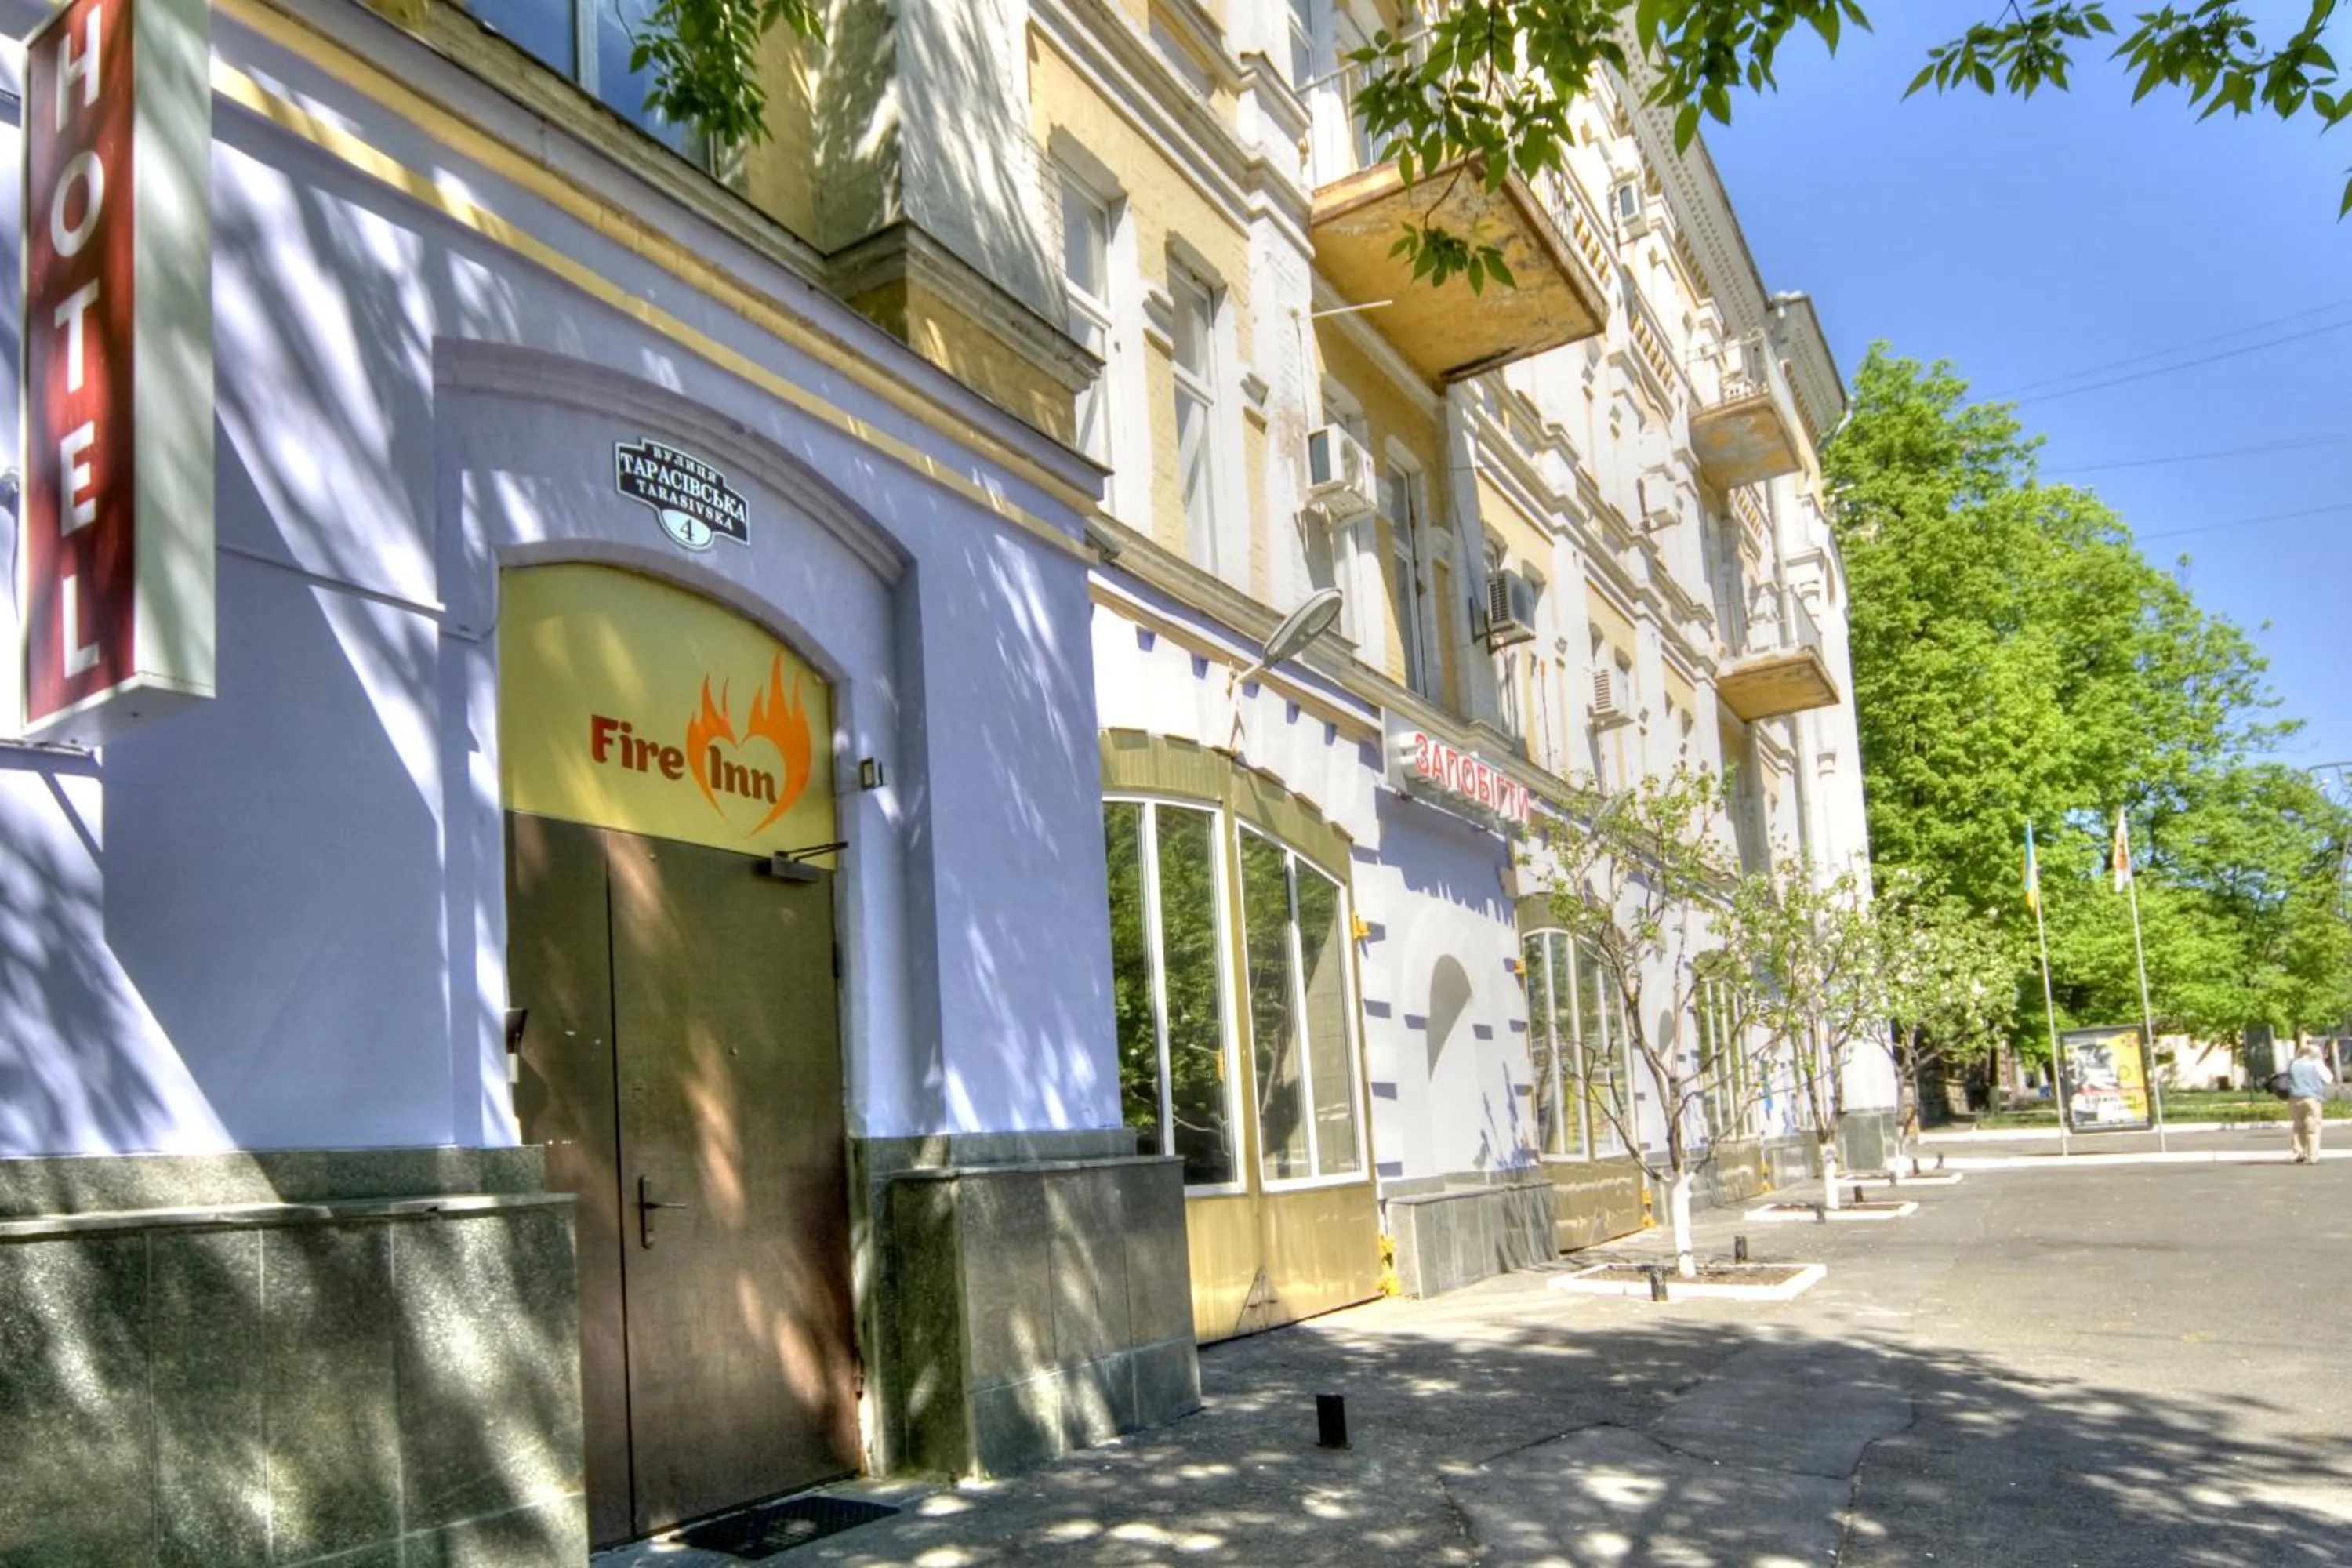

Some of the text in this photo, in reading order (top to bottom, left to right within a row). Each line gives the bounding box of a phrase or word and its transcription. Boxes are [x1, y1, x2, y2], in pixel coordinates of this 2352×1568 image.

[49, 4, 106, 679] HOTEL
[620, 452, 746, 524] ТАРАСІВСЬКА
[636, 479, 734, 531] TARASIVSKA
[680, 518, 695, 542] 4
[590, 713, 777, 805] Fire Inn
